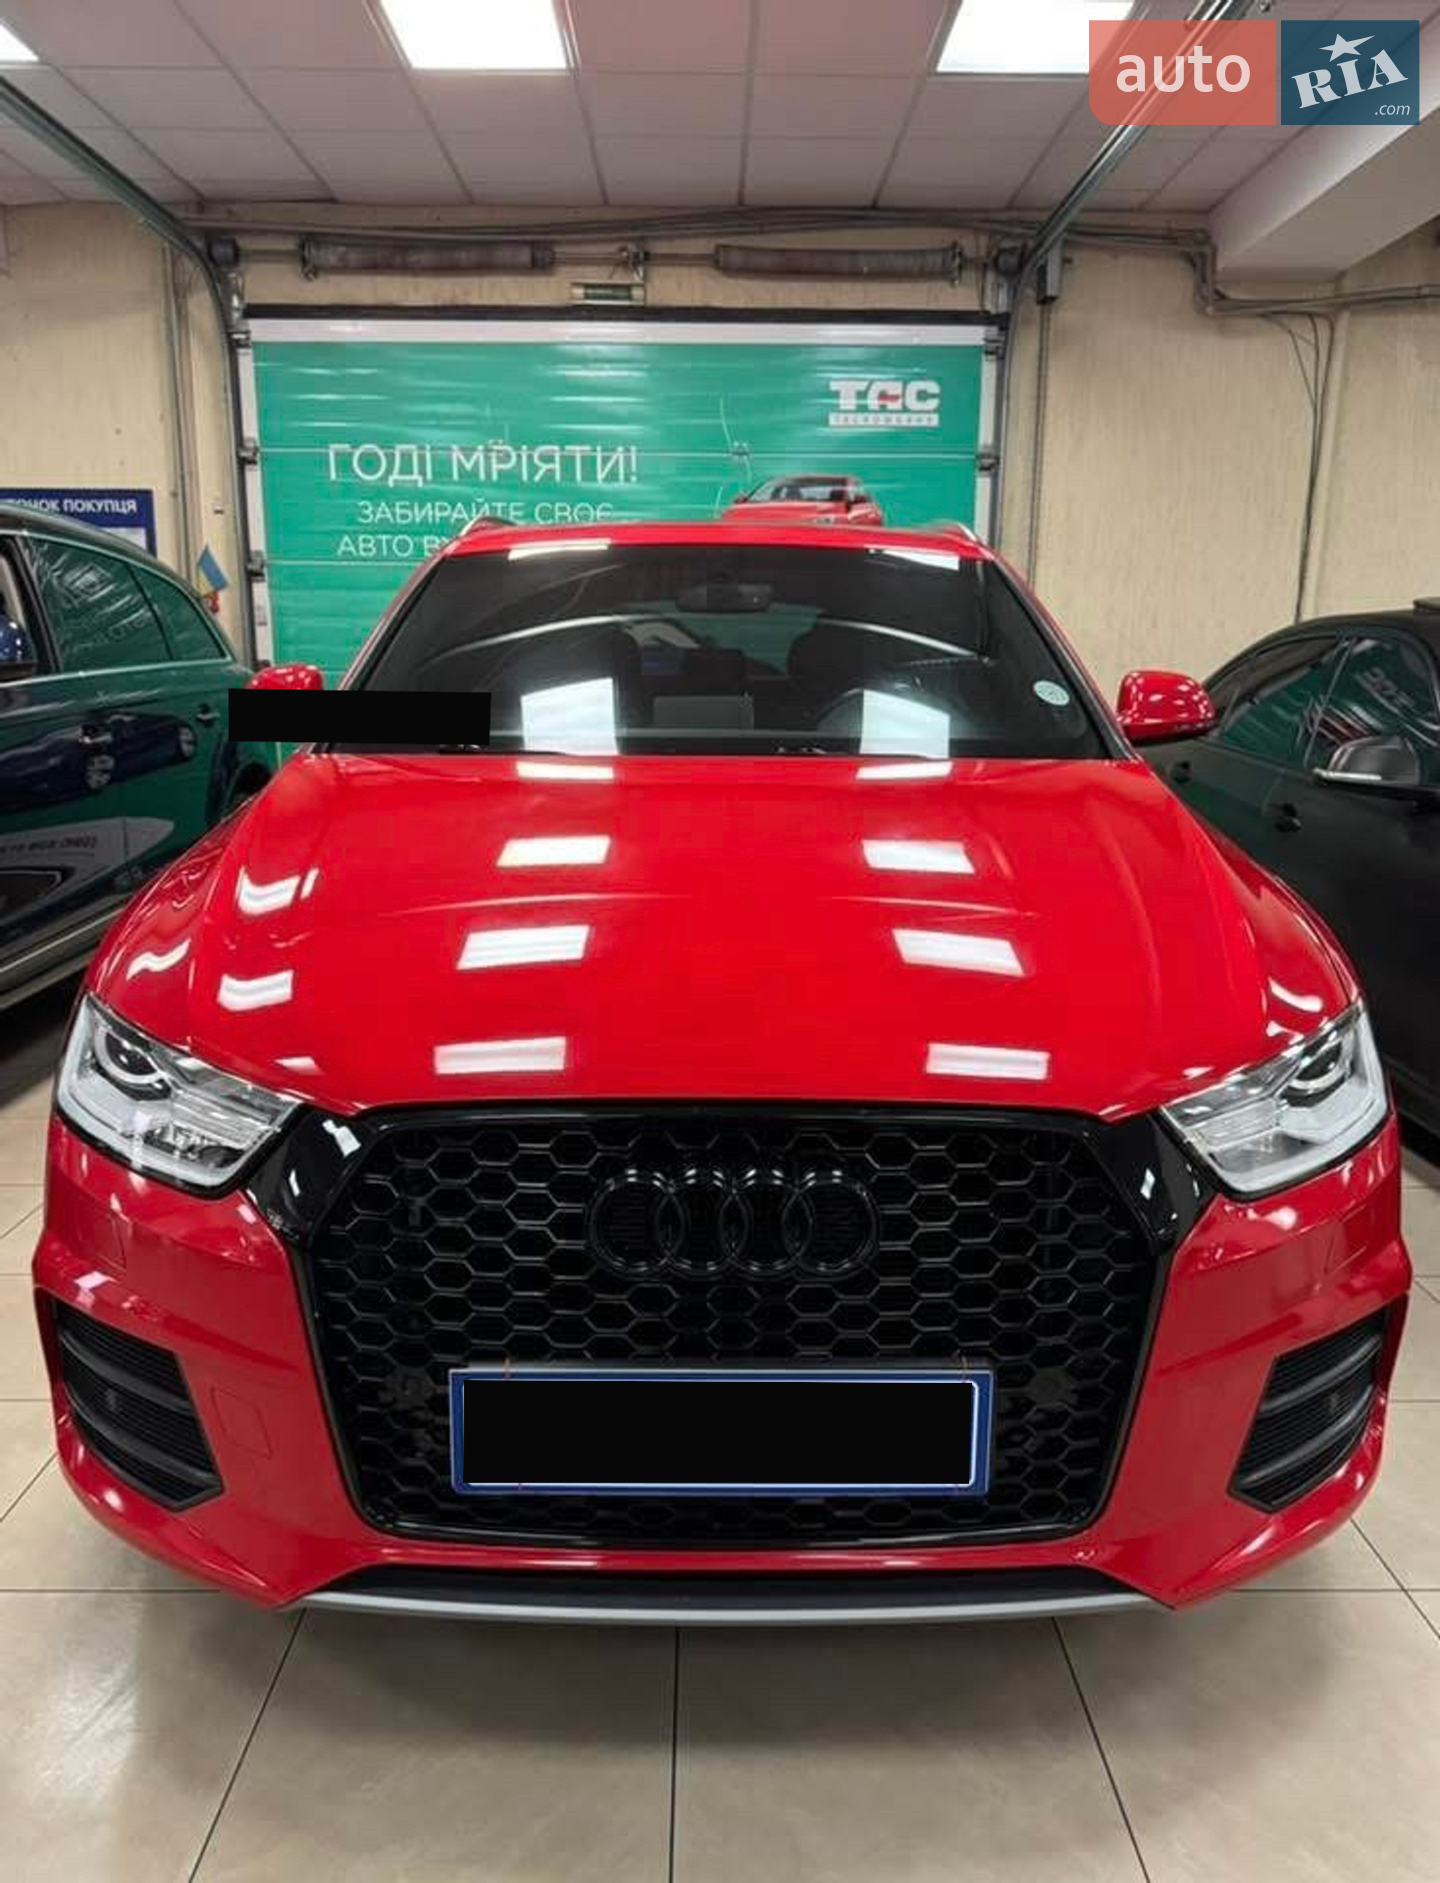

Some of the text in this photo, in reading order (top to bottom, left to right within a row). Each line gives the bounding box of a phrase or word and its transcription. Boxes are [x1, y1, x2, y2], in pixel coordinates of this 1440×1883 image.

[328, 443, 638, 487] ГОДІ МРІЯТИ!
[62, 498, 137, 514] ПОКУПЦЯ
[357, 498, 614, 525] ЗАБИРАЙТЕ СВОЄ
[337, 534, 413, 557] АВТО
